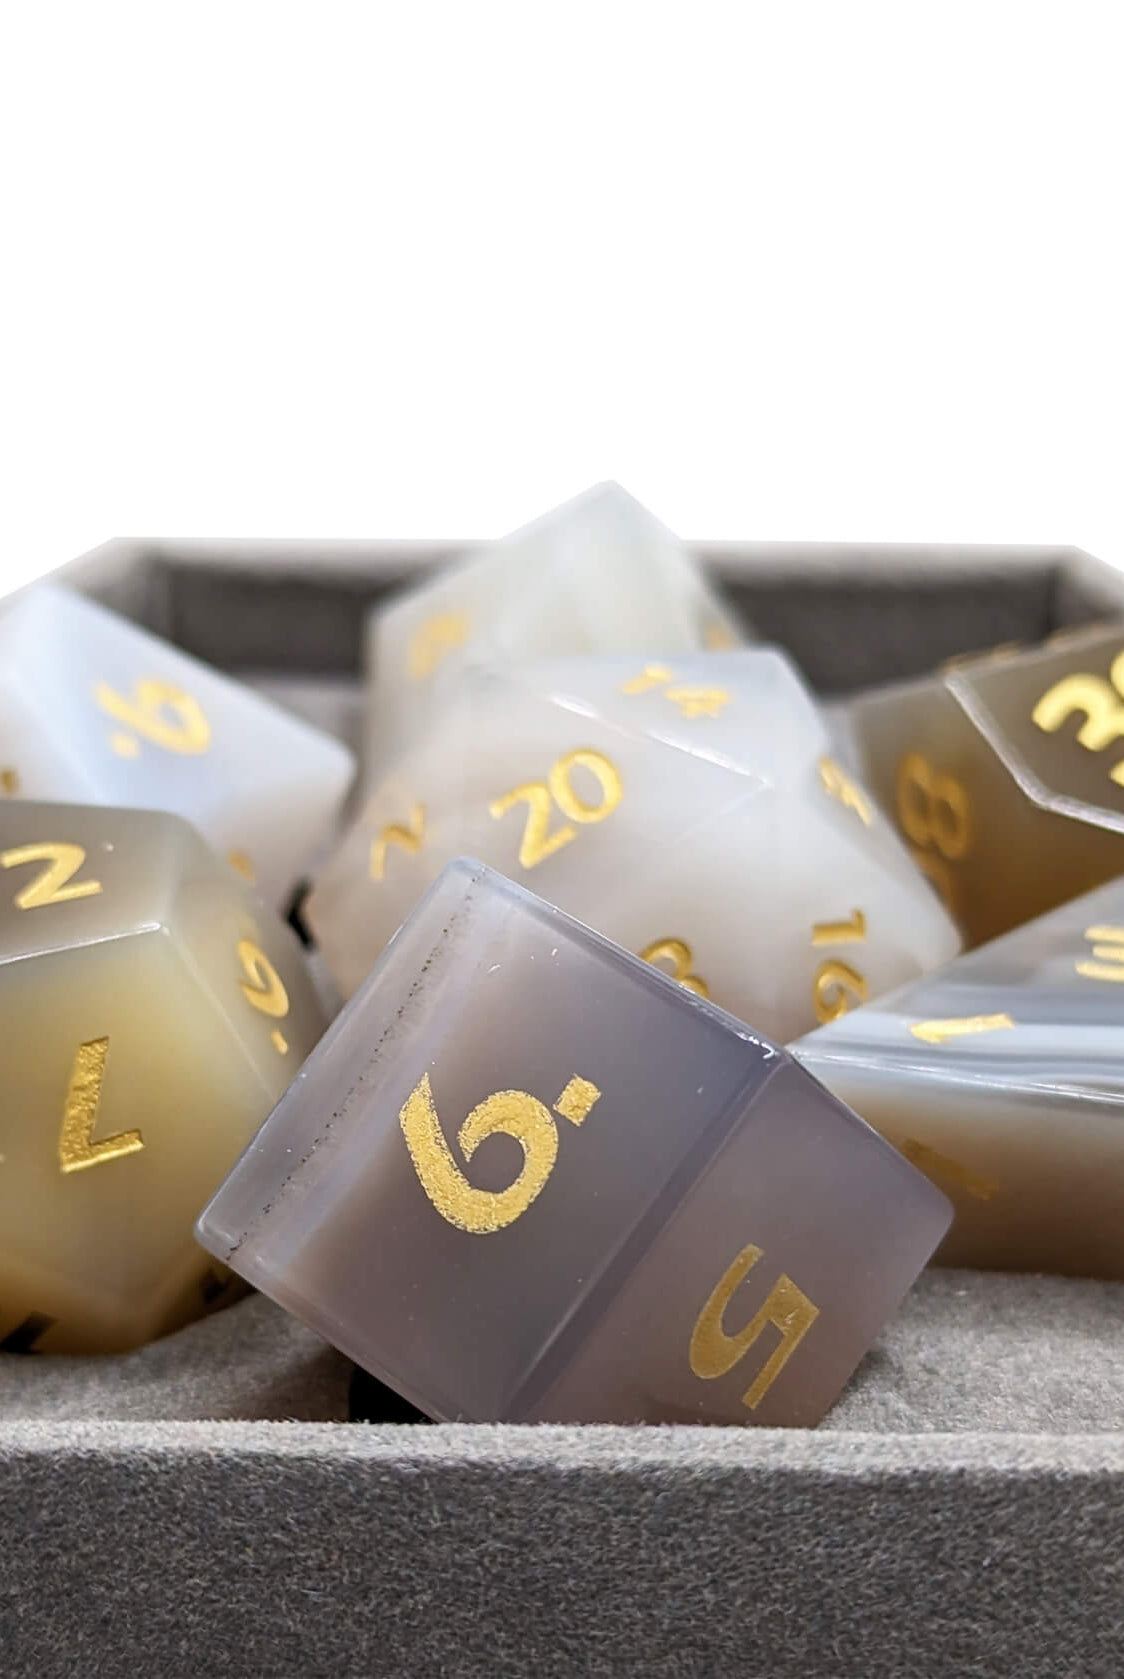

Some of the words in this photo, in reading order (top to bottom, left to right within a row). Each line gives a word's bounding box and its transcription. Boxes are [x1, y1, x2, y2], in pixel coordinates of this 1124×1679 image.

[489, 748, 624, 869] 20
[0, 842, 102, 910] 2
[811, 908, 868, 1025] 16
[59, 1034, 145, 1174] 7
[689, 1242, 820, 1411] 5
